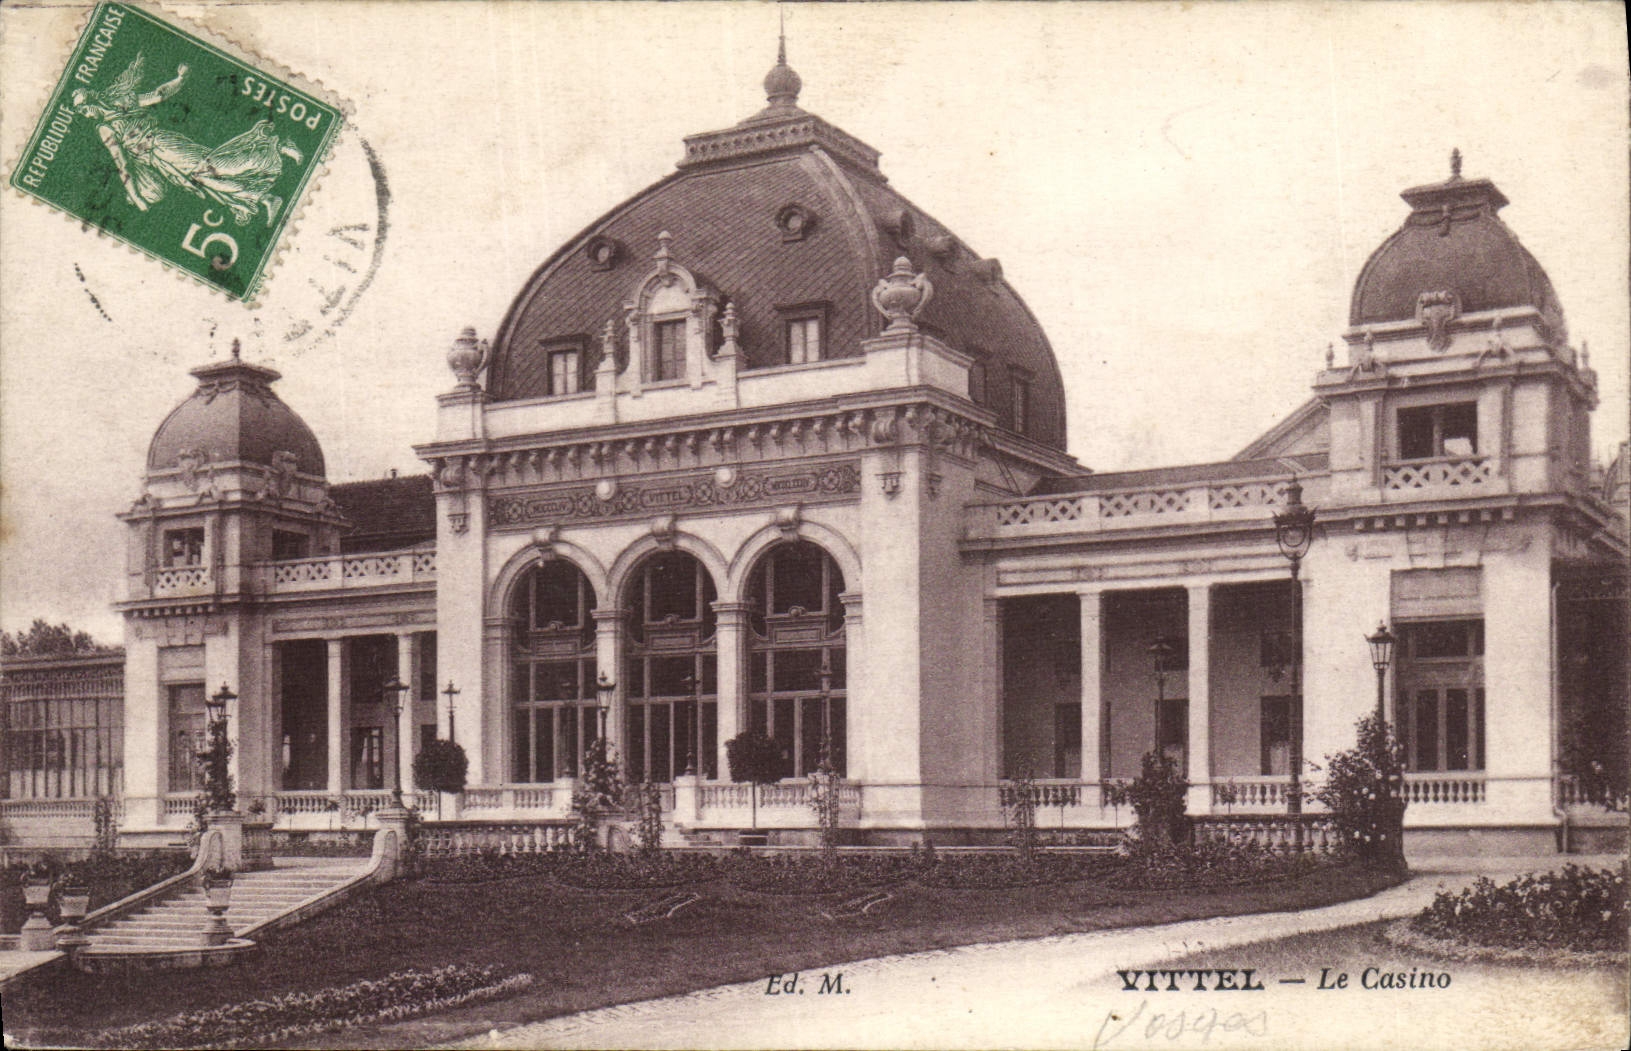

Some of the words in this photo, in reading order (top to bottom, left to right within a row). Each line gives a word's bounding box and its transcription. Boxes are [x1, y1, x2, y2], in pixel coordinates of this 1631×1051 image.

[75, 6, 126, 84] FRANÇAISE
[241, 76, 322, 130] POSTES
[647, 490, 684, 504] VITTEL
